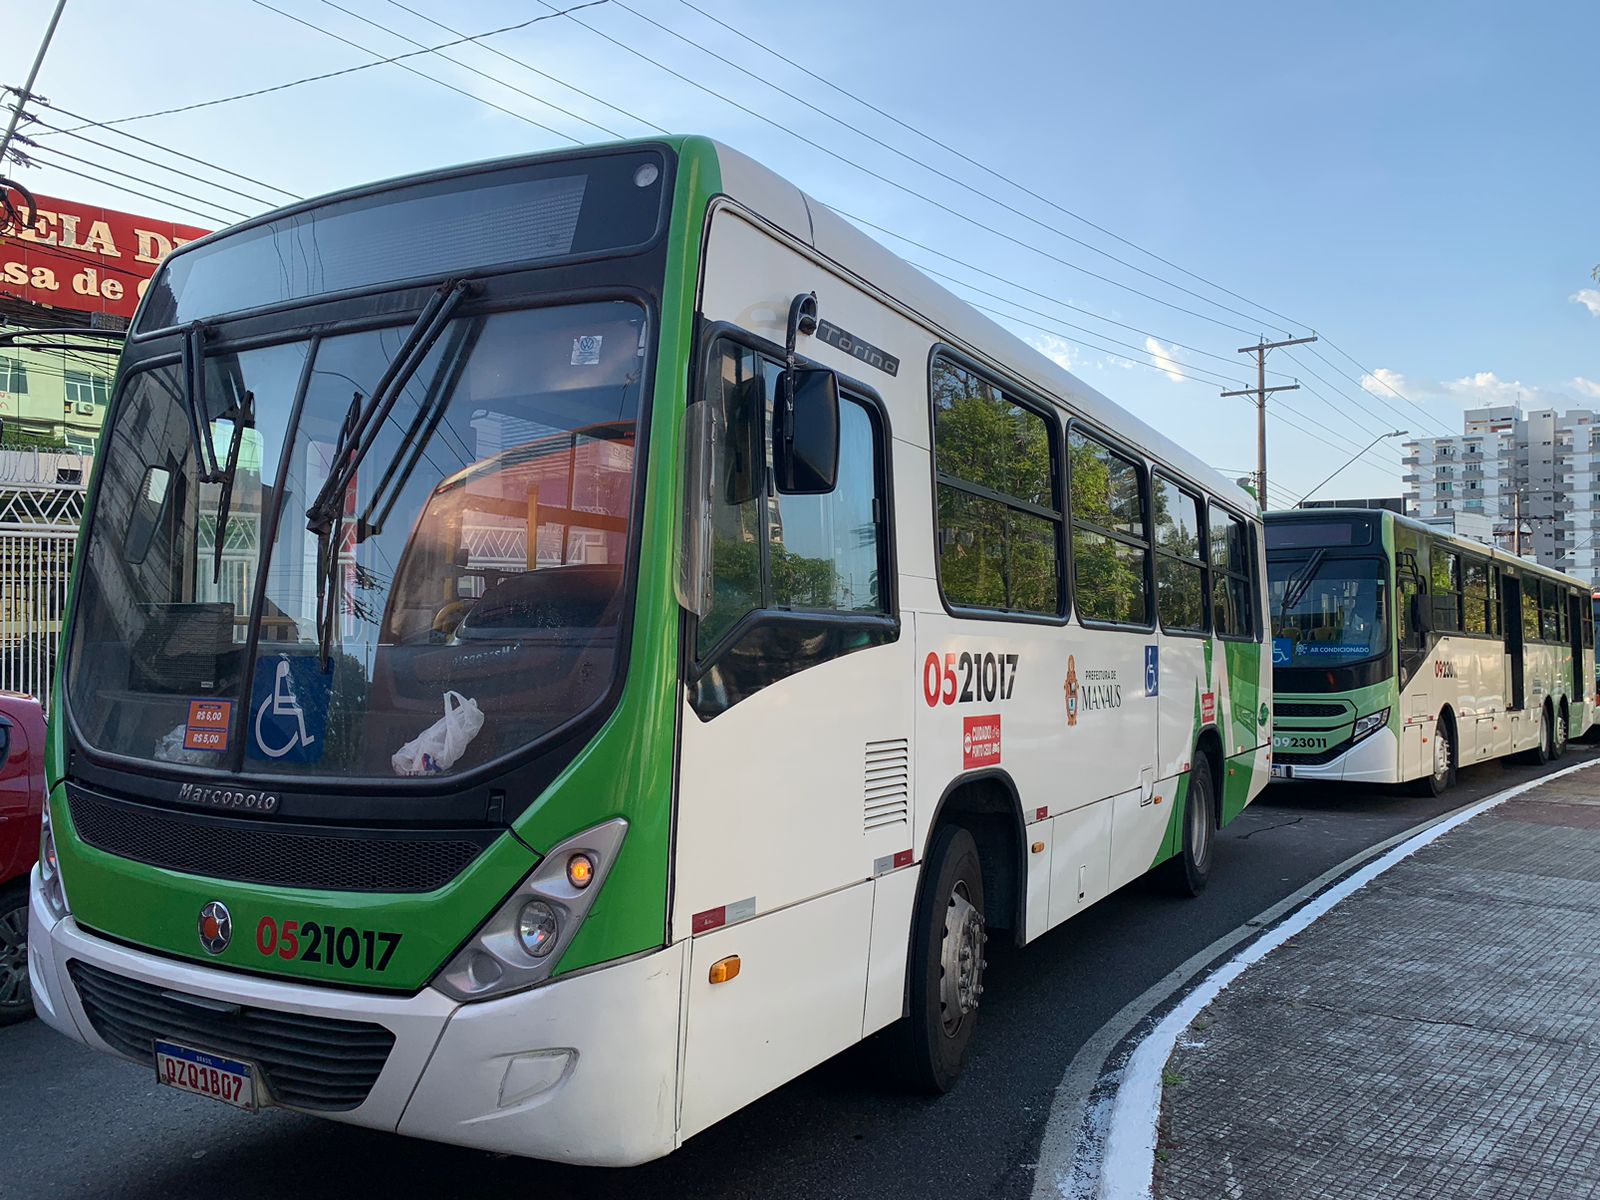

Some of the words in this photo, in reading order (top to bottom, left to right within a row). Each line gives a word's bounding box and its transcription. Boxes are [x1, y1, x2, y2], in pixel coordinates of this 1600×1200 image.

[0, 261, 60, 291] sa
[72, 267, 124, 300] de
[820, 323, 898, 376] Torino
[923, 651, 1019, 707] 0521017
[1085, 670, 1110, 680] PREFEITURA
[1110, 670, 1117, 680] DE
[1082, 684, 1121, 711] MANAUS
[206, 711, 222, 721] 6,00
[203, 734, 219, 744] 5,00
[1273, 737, 1327, 748] 0923011
[178, 783, 276, 811] Marcopolo
[256, 916, 403, 972] 0521017
[196, 1055, 213, 1065] BRASIL
